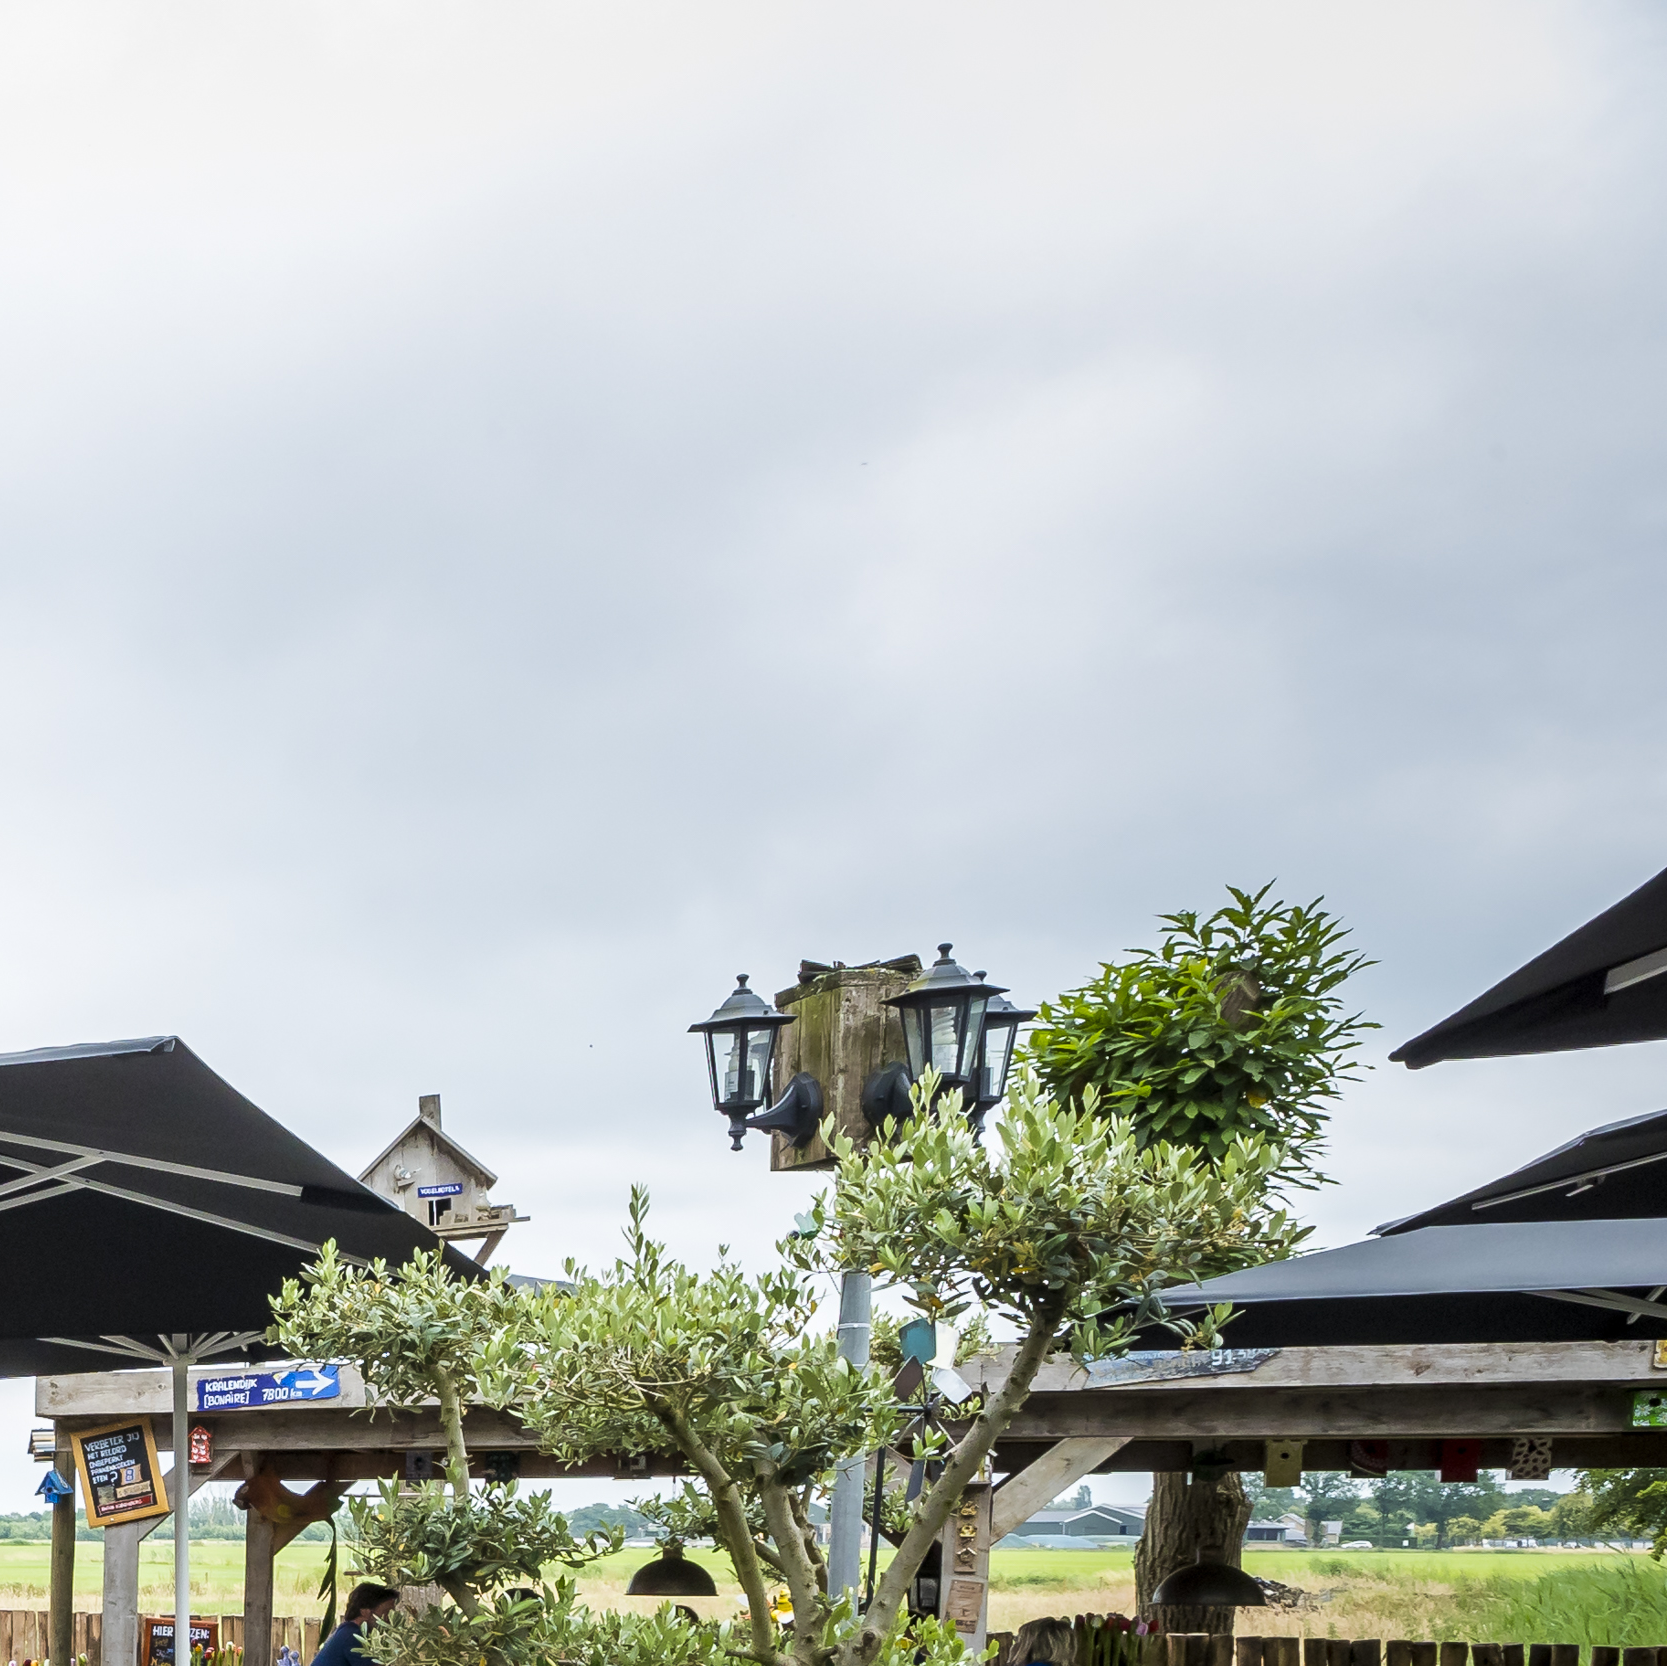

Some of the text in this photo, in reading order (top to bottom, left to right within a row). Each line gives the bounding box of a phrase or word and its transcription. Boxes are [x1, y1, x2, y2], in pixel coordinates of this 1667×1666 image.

[261, 1387, 289, 1401] 7800
[83, 1434, 125, 1452] VERBETER
[152, 1625, 174, 1637] HIER
